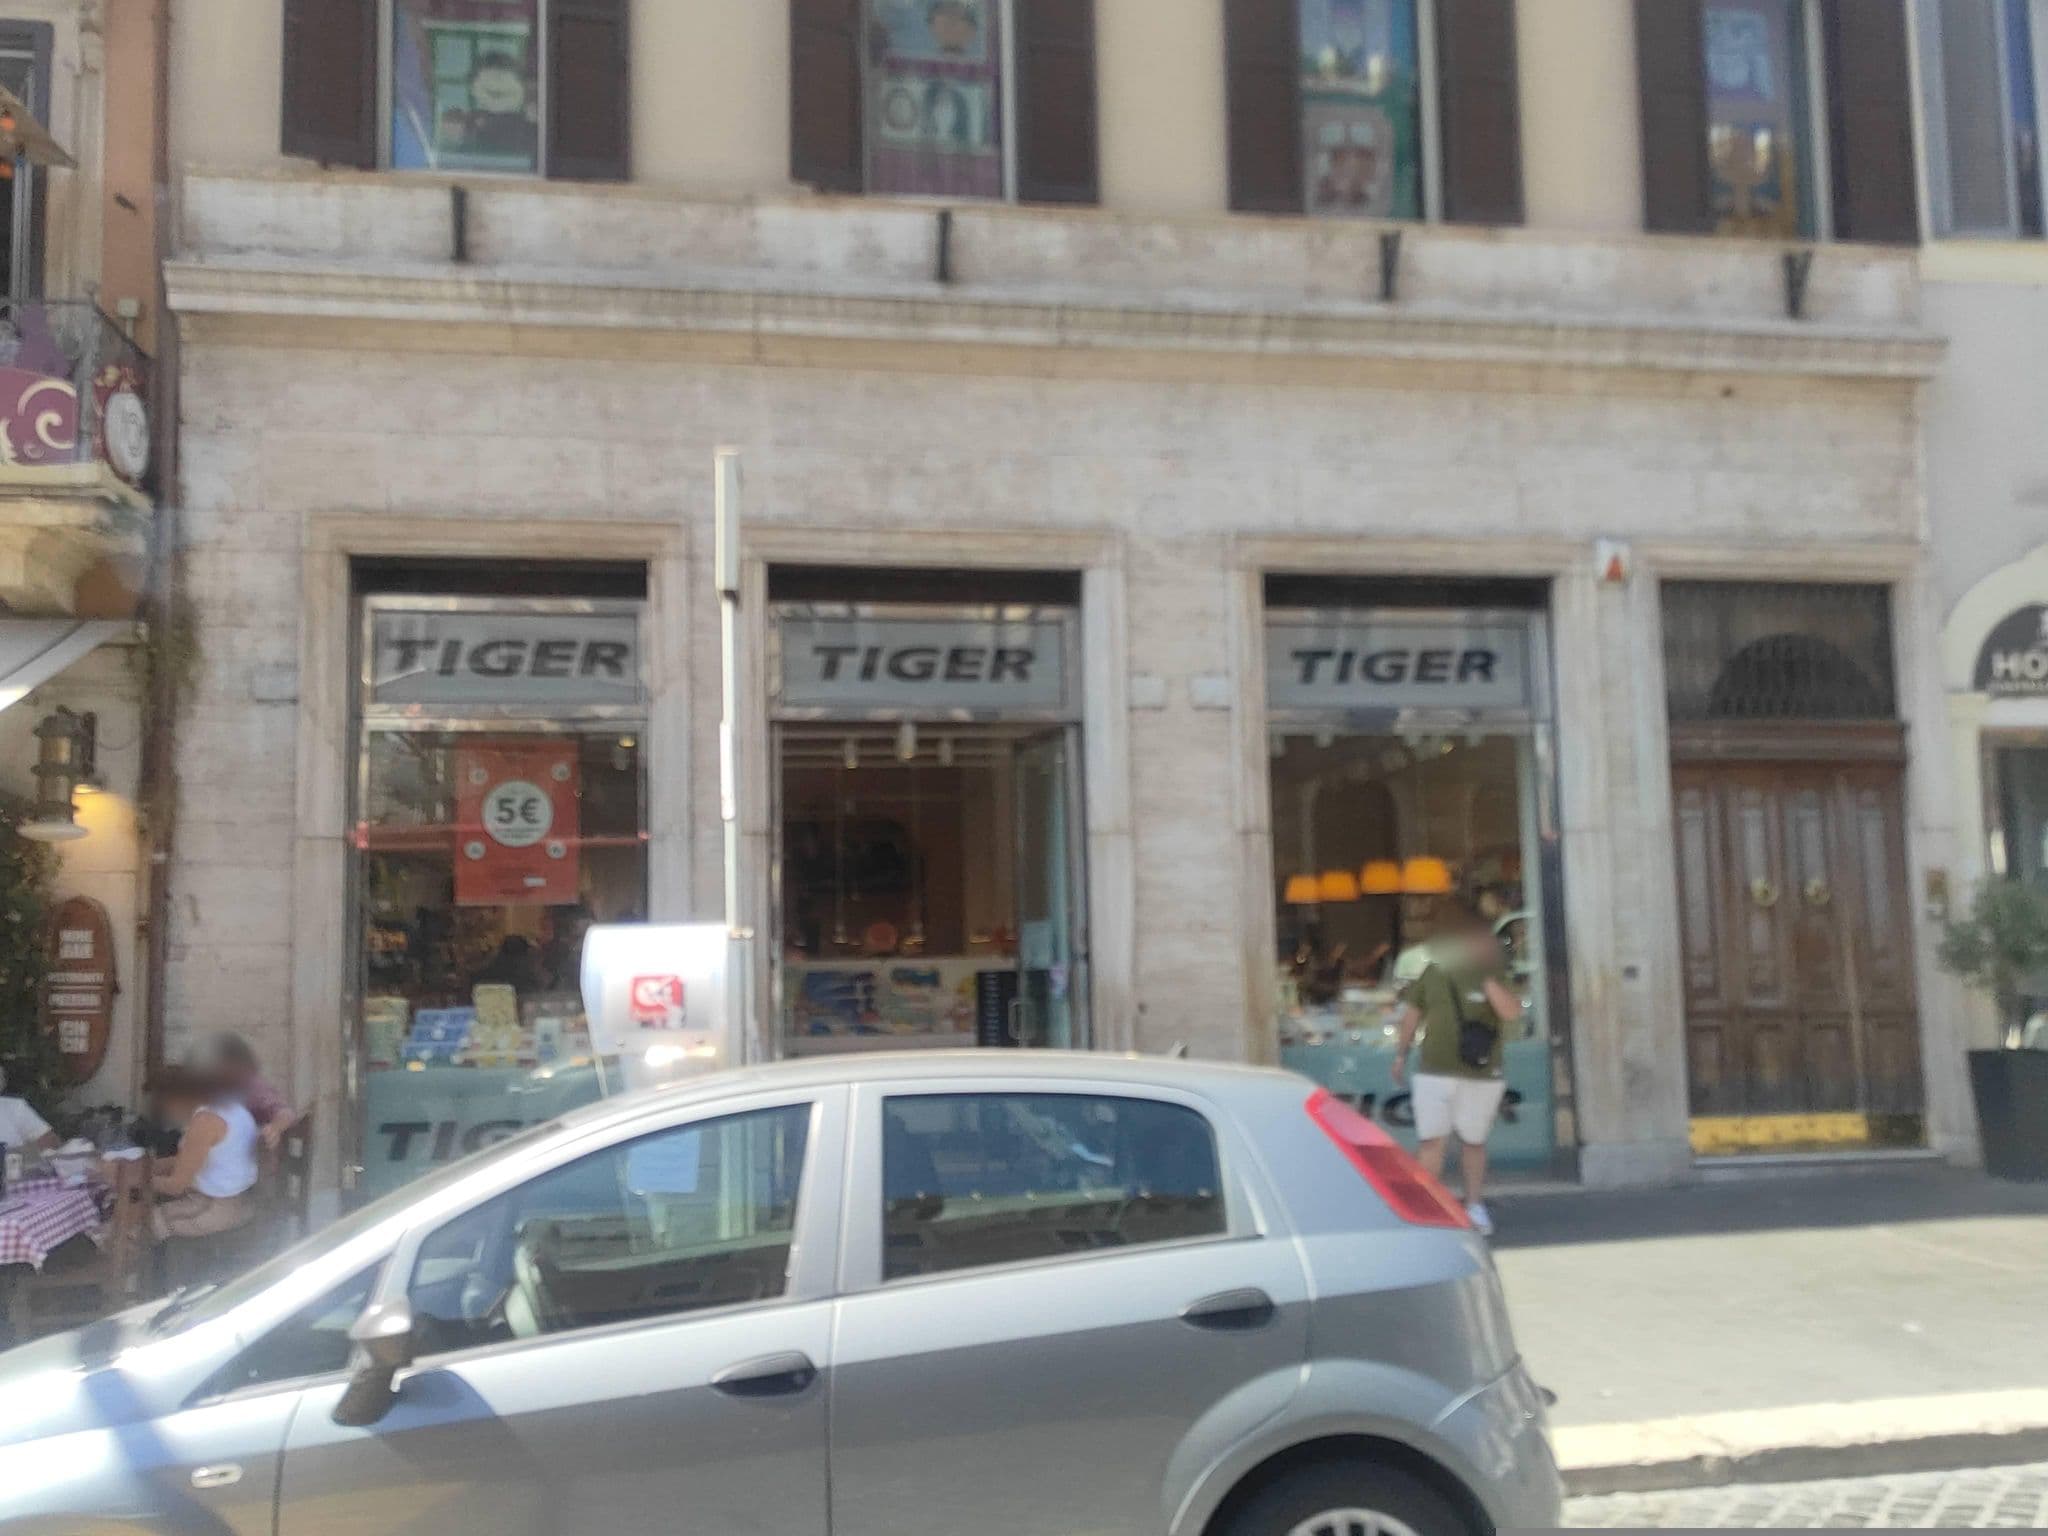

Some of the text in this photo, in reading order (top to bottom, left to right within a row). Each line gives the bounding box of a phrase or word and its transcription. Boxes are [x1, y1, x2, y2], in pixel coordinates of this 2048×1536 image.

[386, 638, 630, 678] TIGER
[812, 645, 1037, 682] TIGER
[1292, 647, 1496, 684] TIGER
[494, 797, 541, 825] 5€
